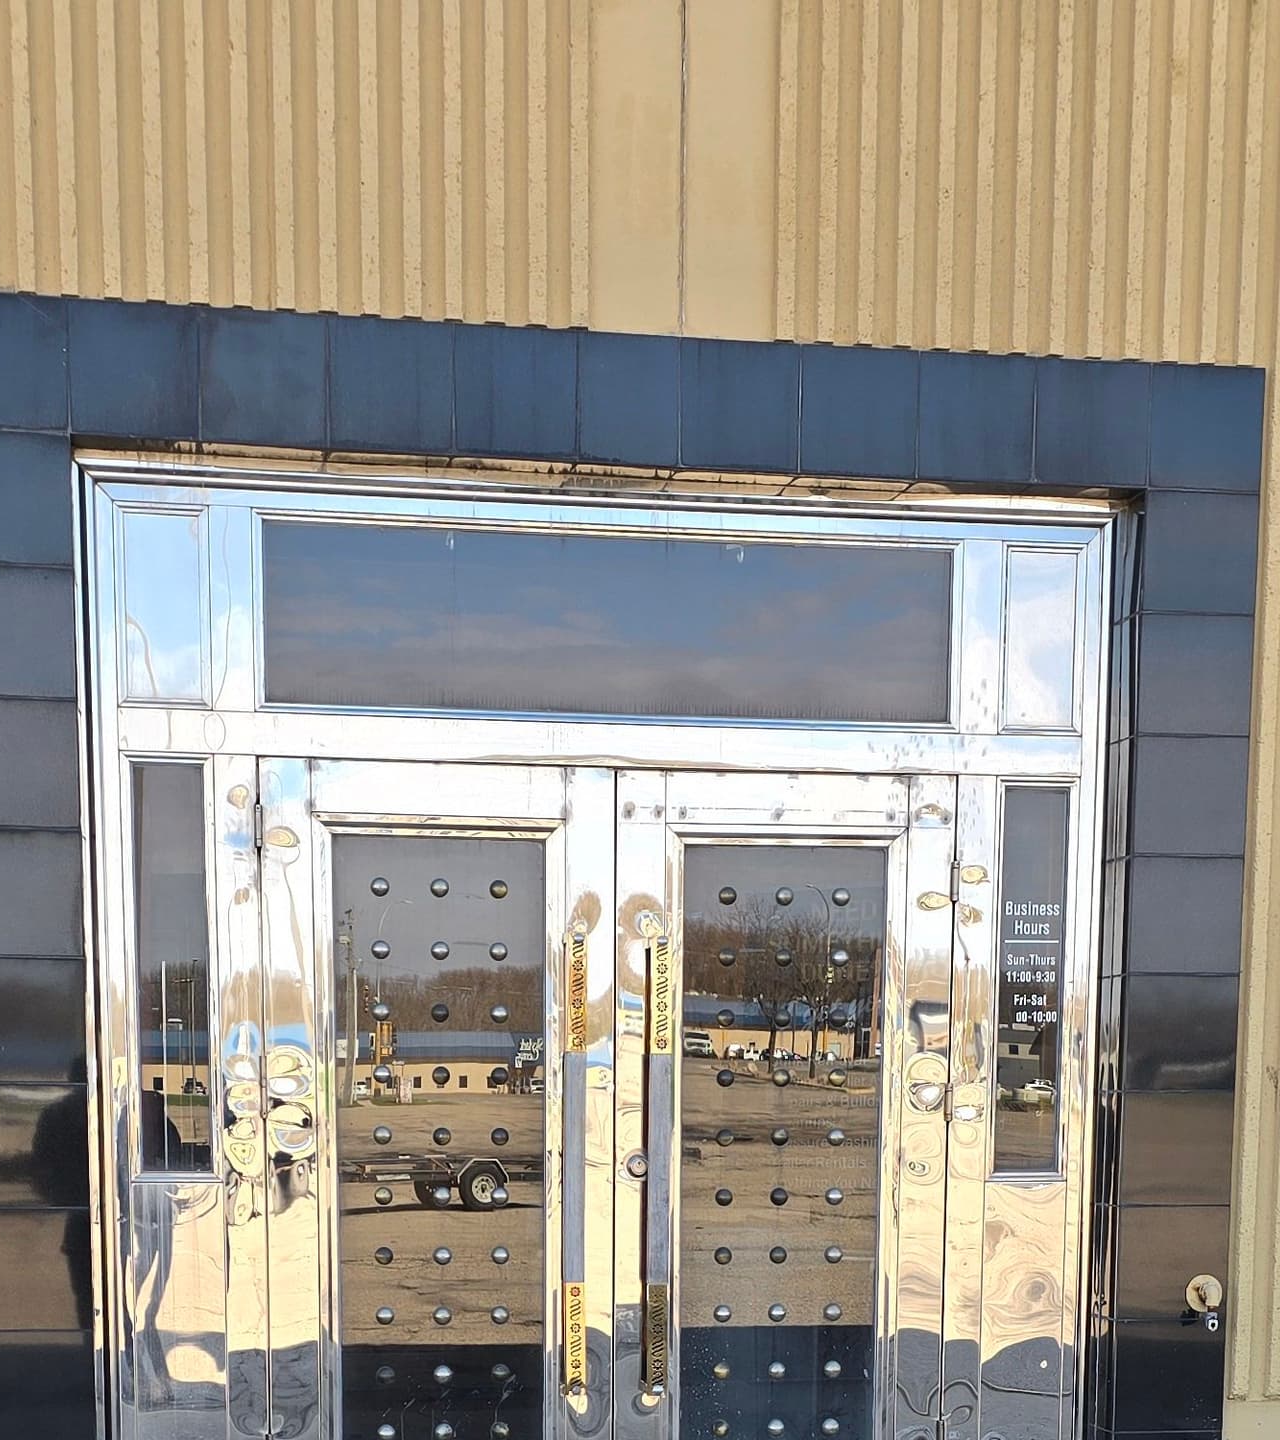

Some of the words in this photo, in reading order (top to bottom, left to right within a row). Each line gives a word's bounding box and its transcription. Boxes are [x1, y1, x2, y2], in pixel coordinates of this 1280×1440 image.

[1005, 900, 1060, 916] Business
[1014, 919, 1050, 935] Hours
[1007, 953, 1056, 966] Sun-Thurs
[1006, 970, 1056, 983] 11:00-9:30
